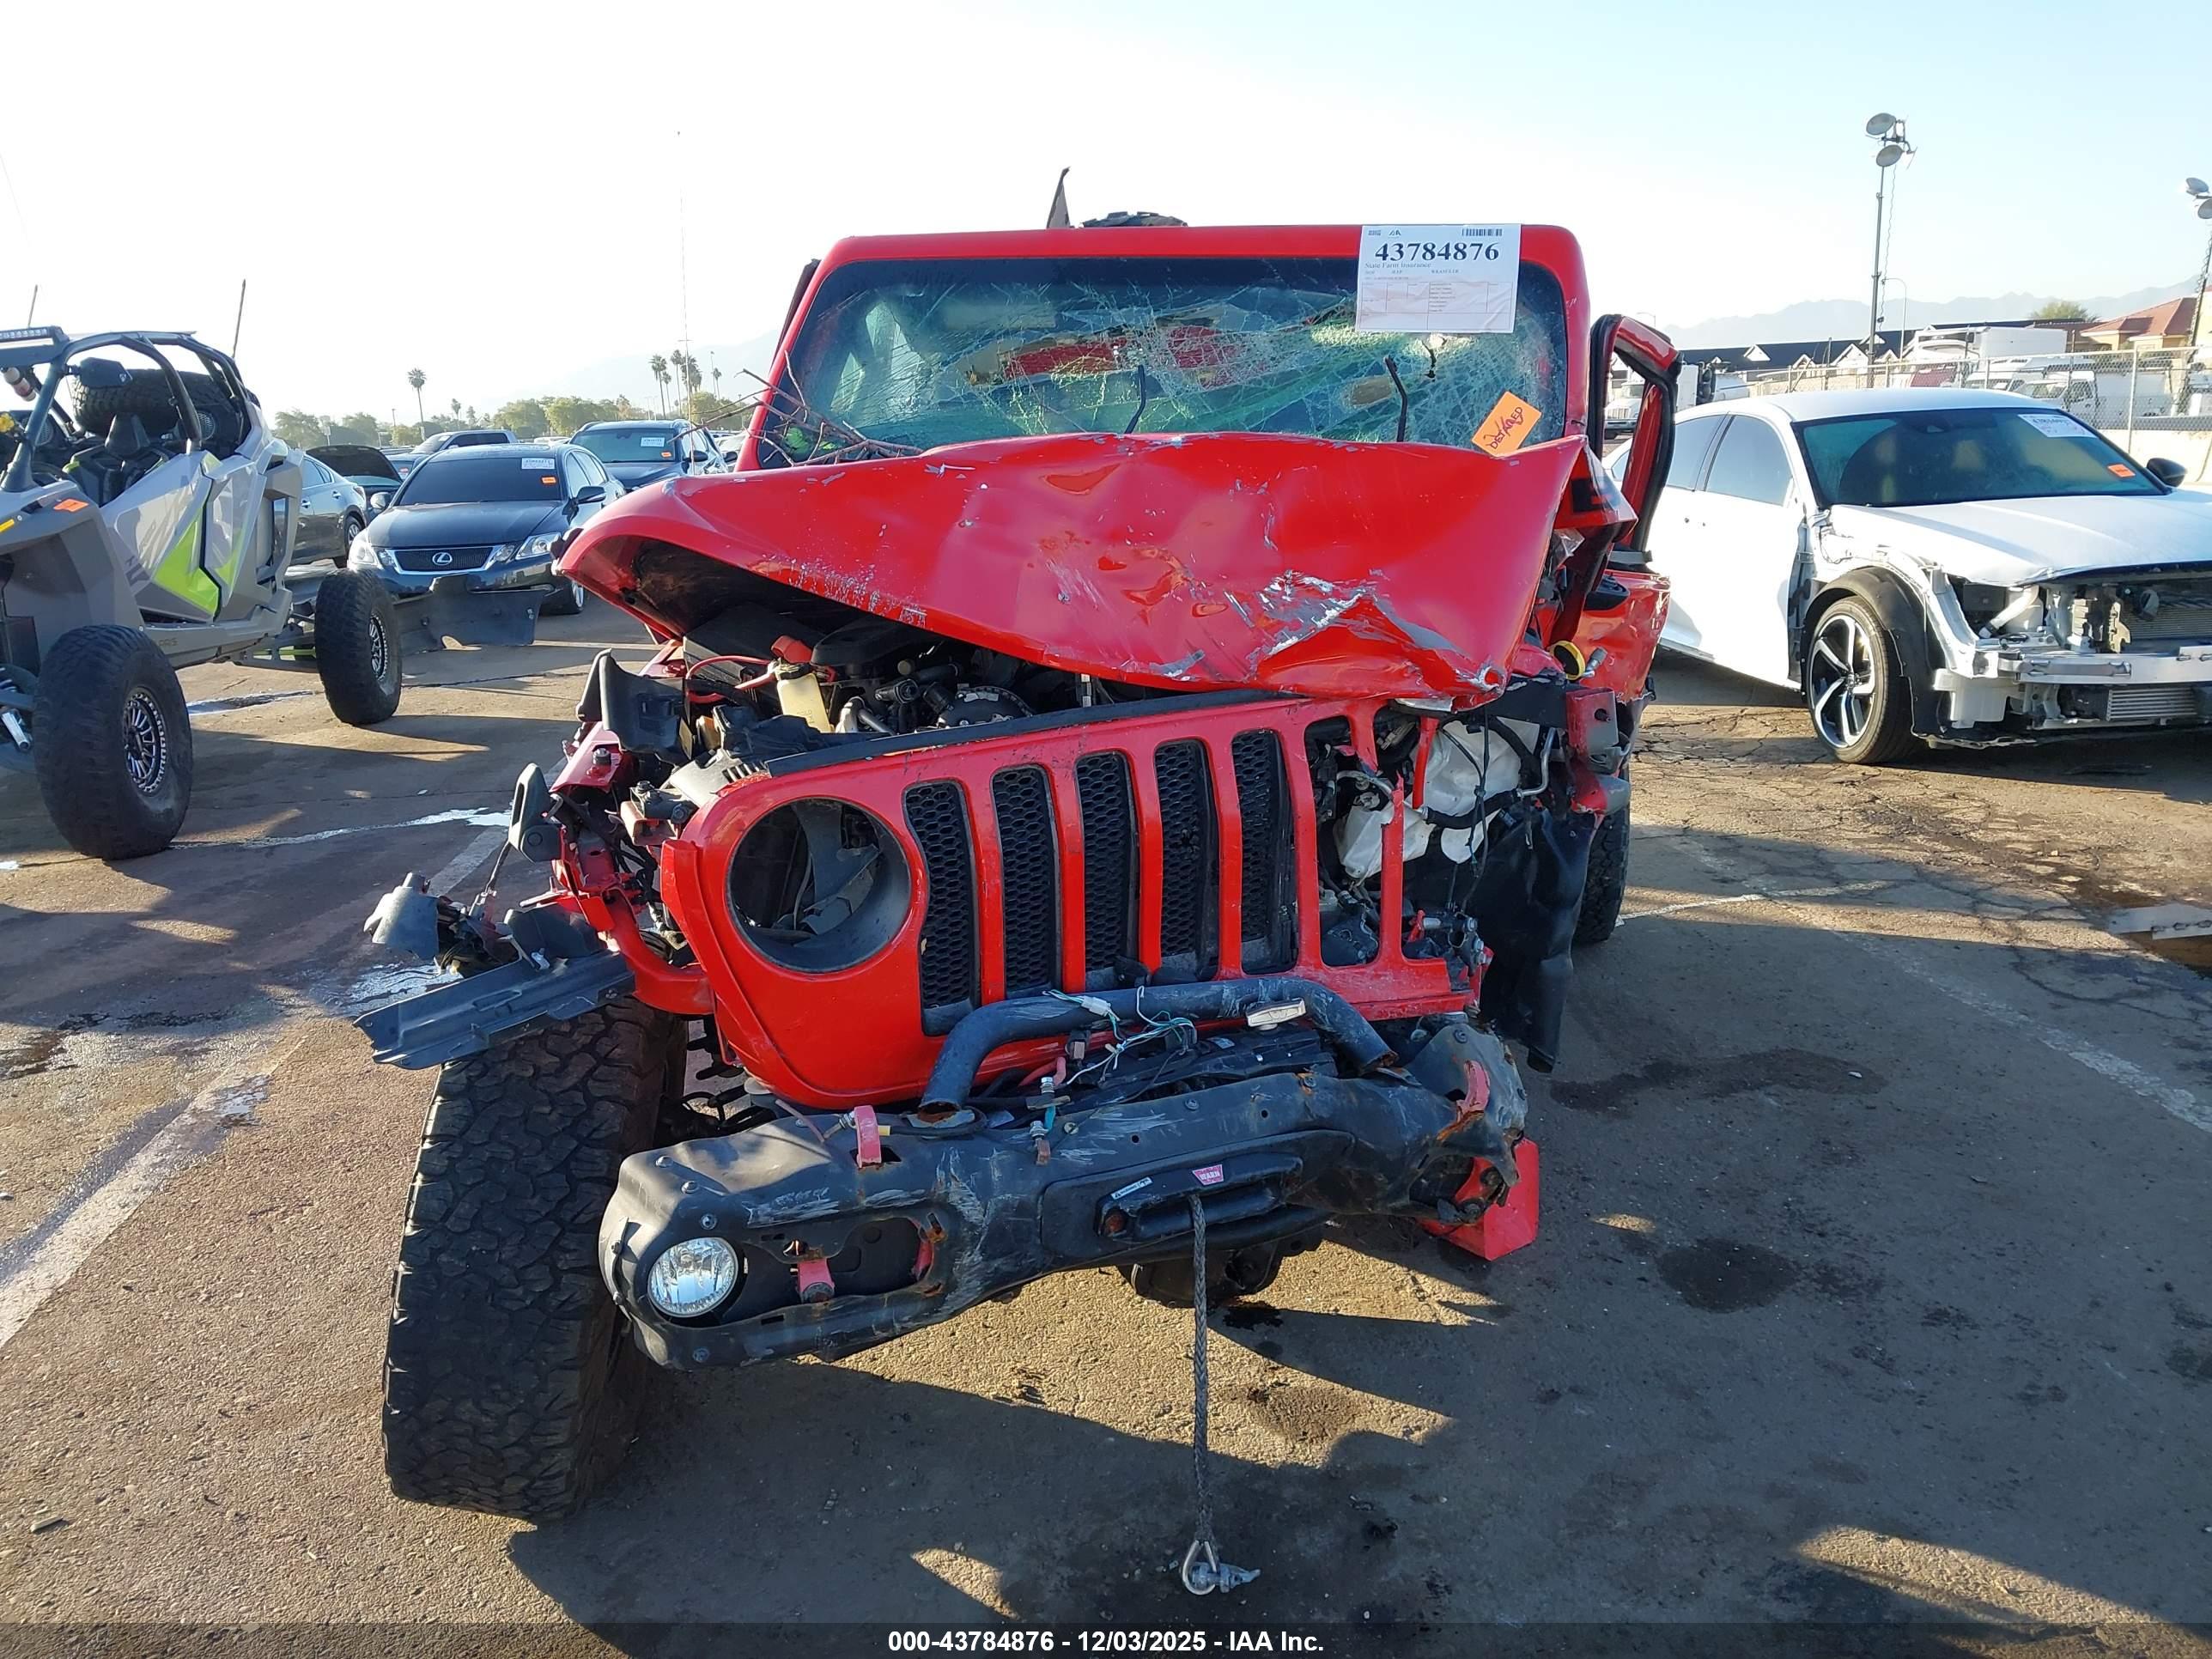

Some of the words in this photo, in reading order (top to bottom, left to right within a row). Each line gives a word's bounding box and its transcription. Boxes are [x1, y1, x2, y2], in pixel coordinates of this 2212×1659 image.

[1375, 242, 1499, 261] 43784876
[1491, 406, 1523, 449] DETAILED
[1199, 1170, 1220, 1181] WARN
